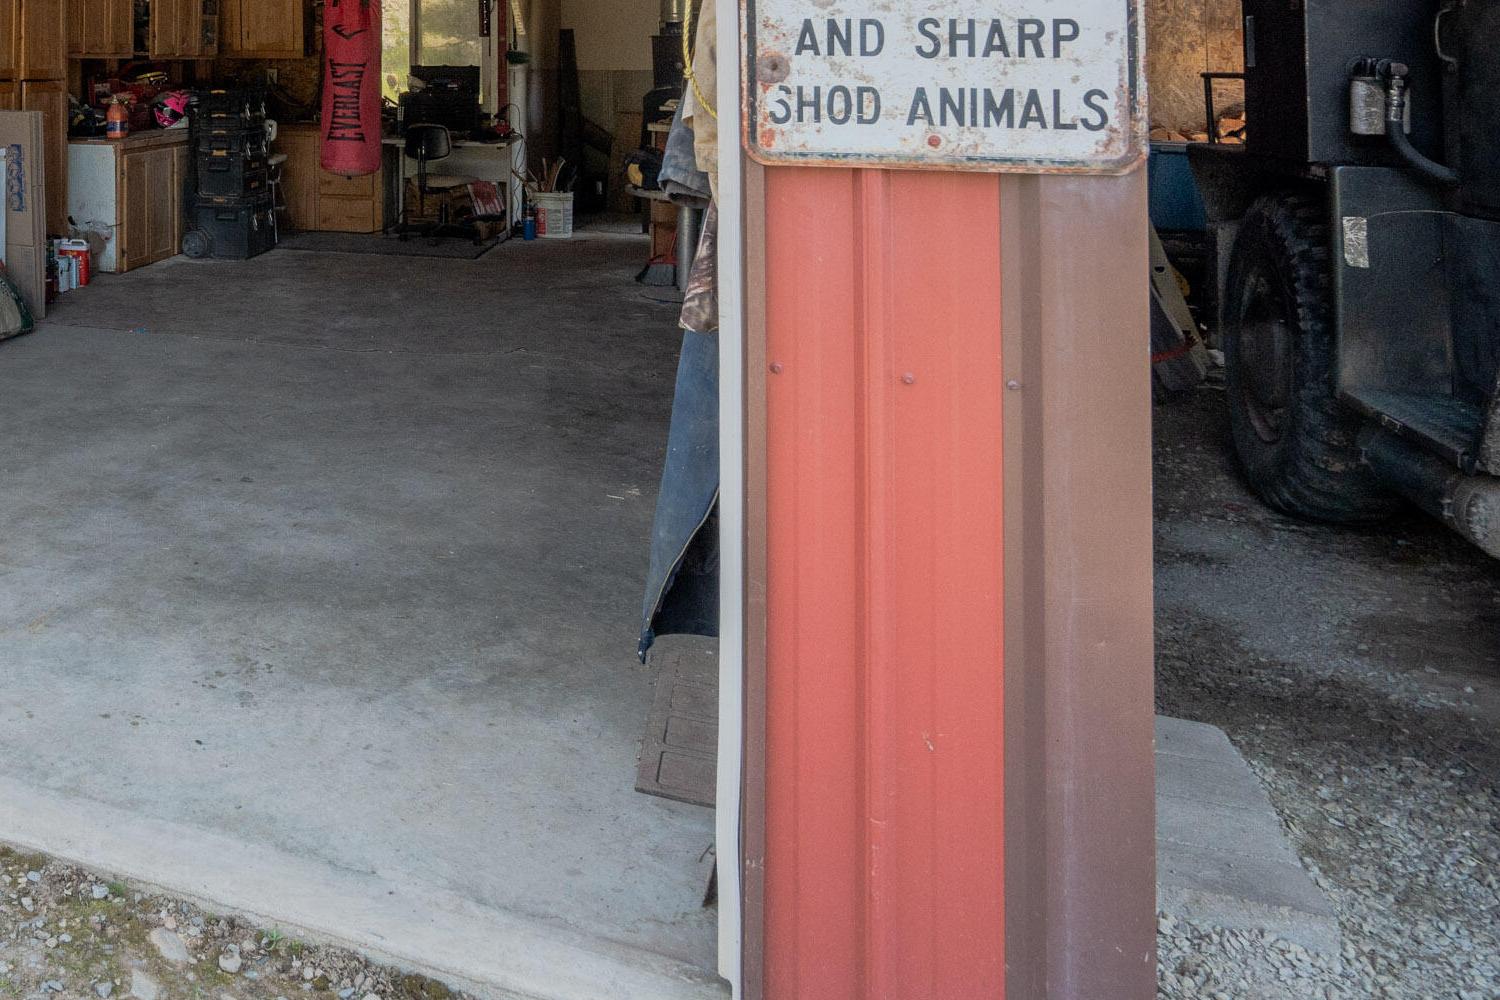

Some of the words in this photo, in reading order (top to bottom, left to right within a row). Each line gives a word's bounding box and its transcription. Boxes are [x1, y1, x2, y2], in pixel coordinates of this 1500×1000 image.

[795, 17, 886, 57] AND
[915, 17, 1081, 60] SHARP
[327, 58, 366, 142] EVERLAST
[769, 85, 882, 127] SHOD
[906, 85, 1111, 132] ANIMALS
